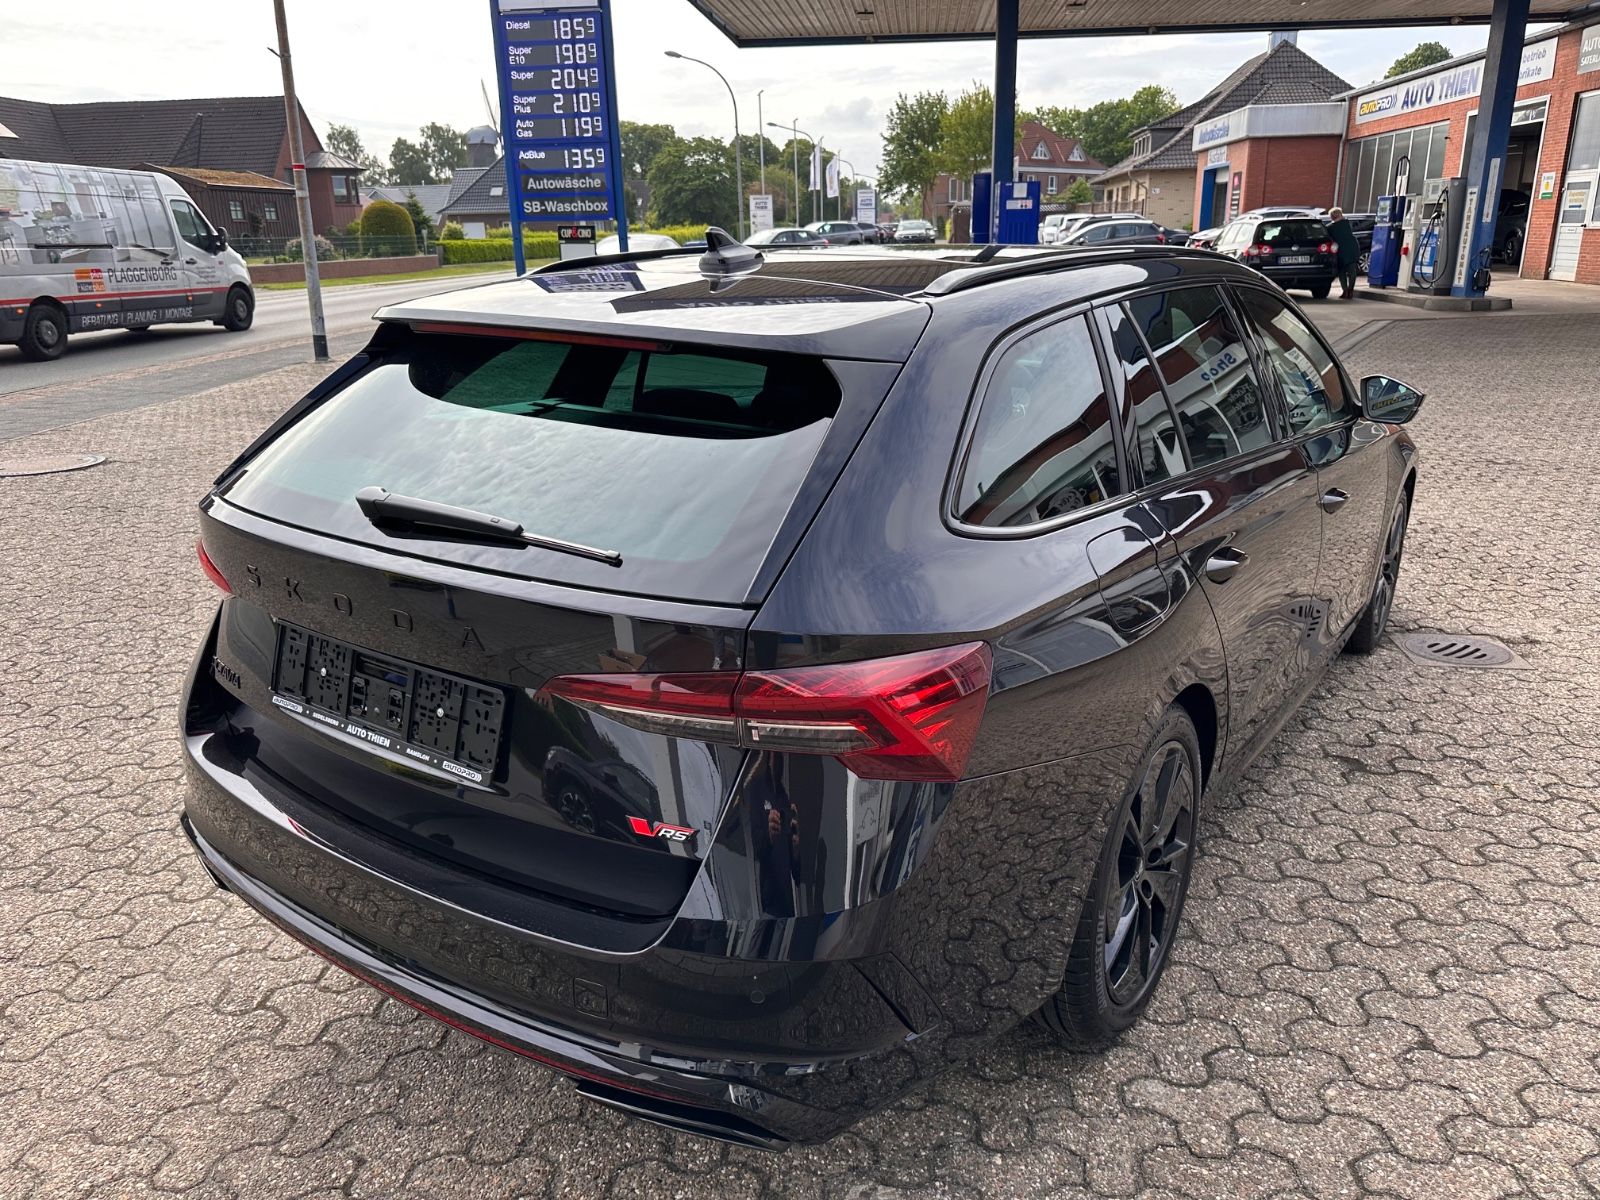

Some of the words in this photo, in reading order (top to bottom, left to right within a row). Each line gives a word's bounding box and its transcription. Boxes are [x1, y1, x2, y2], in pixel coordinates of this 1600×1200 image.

[505, 20, 531, 30] Diesel
[553, 17, 595, 39] 1859
[508, 46, 532, 57] Super
[555, 43, 597, 64] 1989
[509, 56, 525, 65] E10
[510, 70, 534, 81] Super
[551, 68, 599, 89] 2049
[1401, 80, 1435, 110] AUTO
[1439, 67, 1481, 101] THIEN
[513, 95, 536, 106] Super
[553, 92, 600, 114] 2109
[514, 105, 531, 113] Plus
[516, 119, 534, 128] Auto
[561, 116, 603, 137] 1199
[516, 129, 533, 137] Gas
[518, 150, 546, 160] AdBlue
[564, 148, 605, 169] 1359
[527, 176, 602, 190] Autowäsche
[523, 199, 608, 213] SB-Waschbox
[1457, 198, 1475, 284] TANKAUTOMAT
[107, 266, 178, 284] PLAGGENBORG
[81, 313, 119, 328] BERATUNG
[127, 310, 157, 323] PLANUNG
[165, 306, 193, 319] MONTAGE
[247, 564, 487, 652] SKODA
[346, 724, 367, 738] AUTO
[367, 732, 391, 748] THIEN
